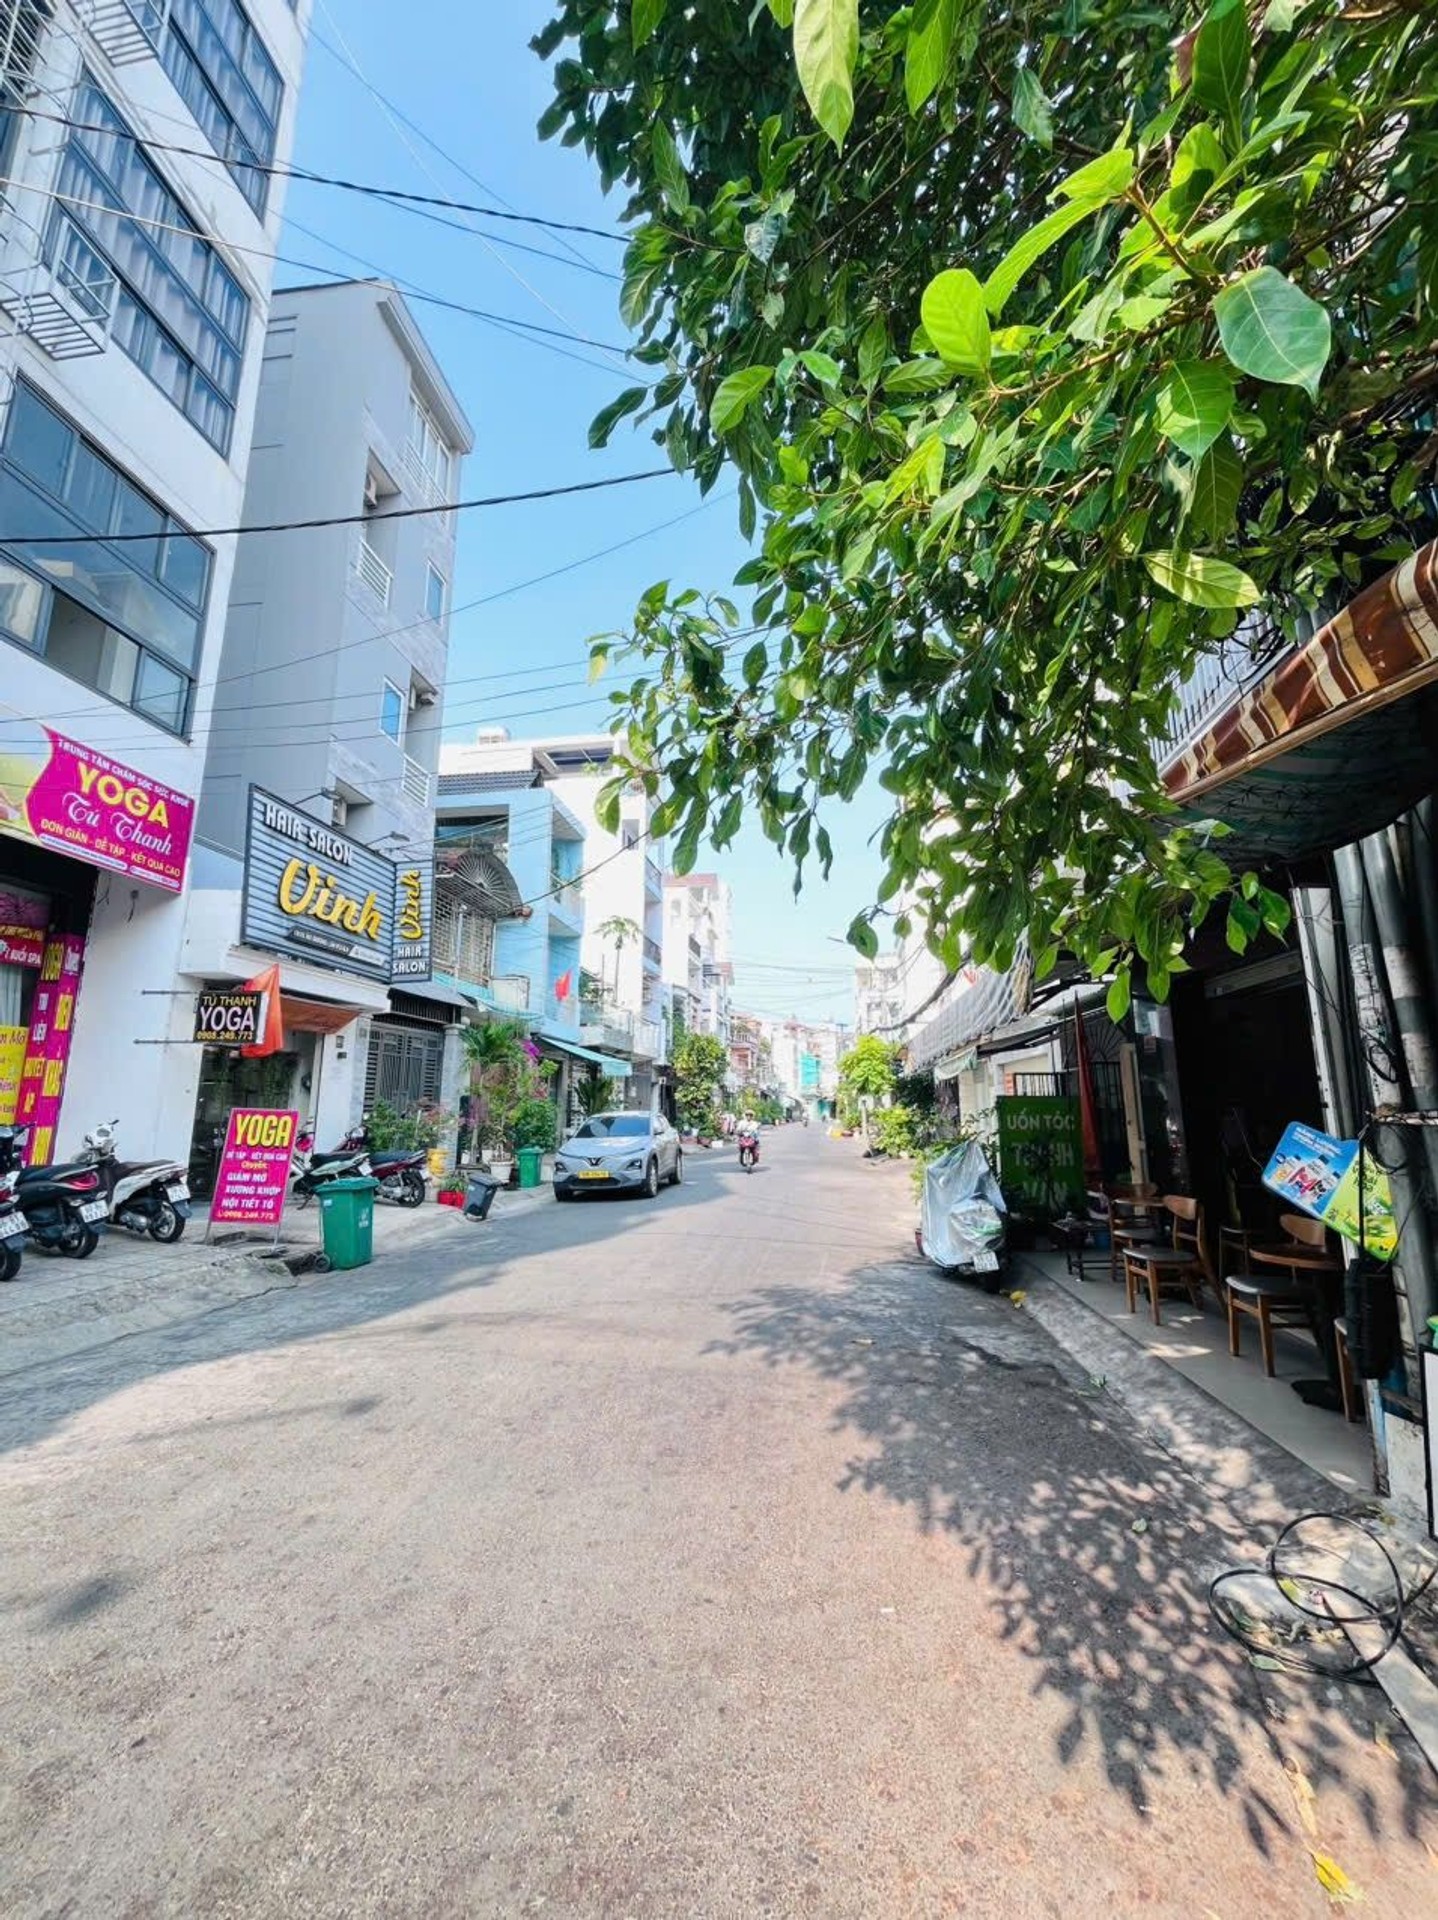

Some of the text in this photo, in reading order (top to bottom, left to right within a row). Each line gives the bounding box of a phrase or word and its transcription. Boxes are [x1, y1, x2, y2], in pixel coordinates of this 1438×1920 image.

[78, 761, 169, 829] YOGA
[62, 792, 100, 827] Tú
[110, 812, 173, 856] Thanh
[265, 803, 353, 865] HAIR SALON
[164, 866, 181, 878] CAO
[279, 857, 383, 941] Vinh
[400, 868, 423, 940] Vinh
[397, 946, 422, 958] HAIR
[392, 961, 426, 974] SALON
[220, 996, 257, 1006] THANH
[200, 1006, 254, 1031] YOGA
[236, 1113, 292, 1147] YOGA
[1006, 1108, 1075, 1130] UỐN TÓC
